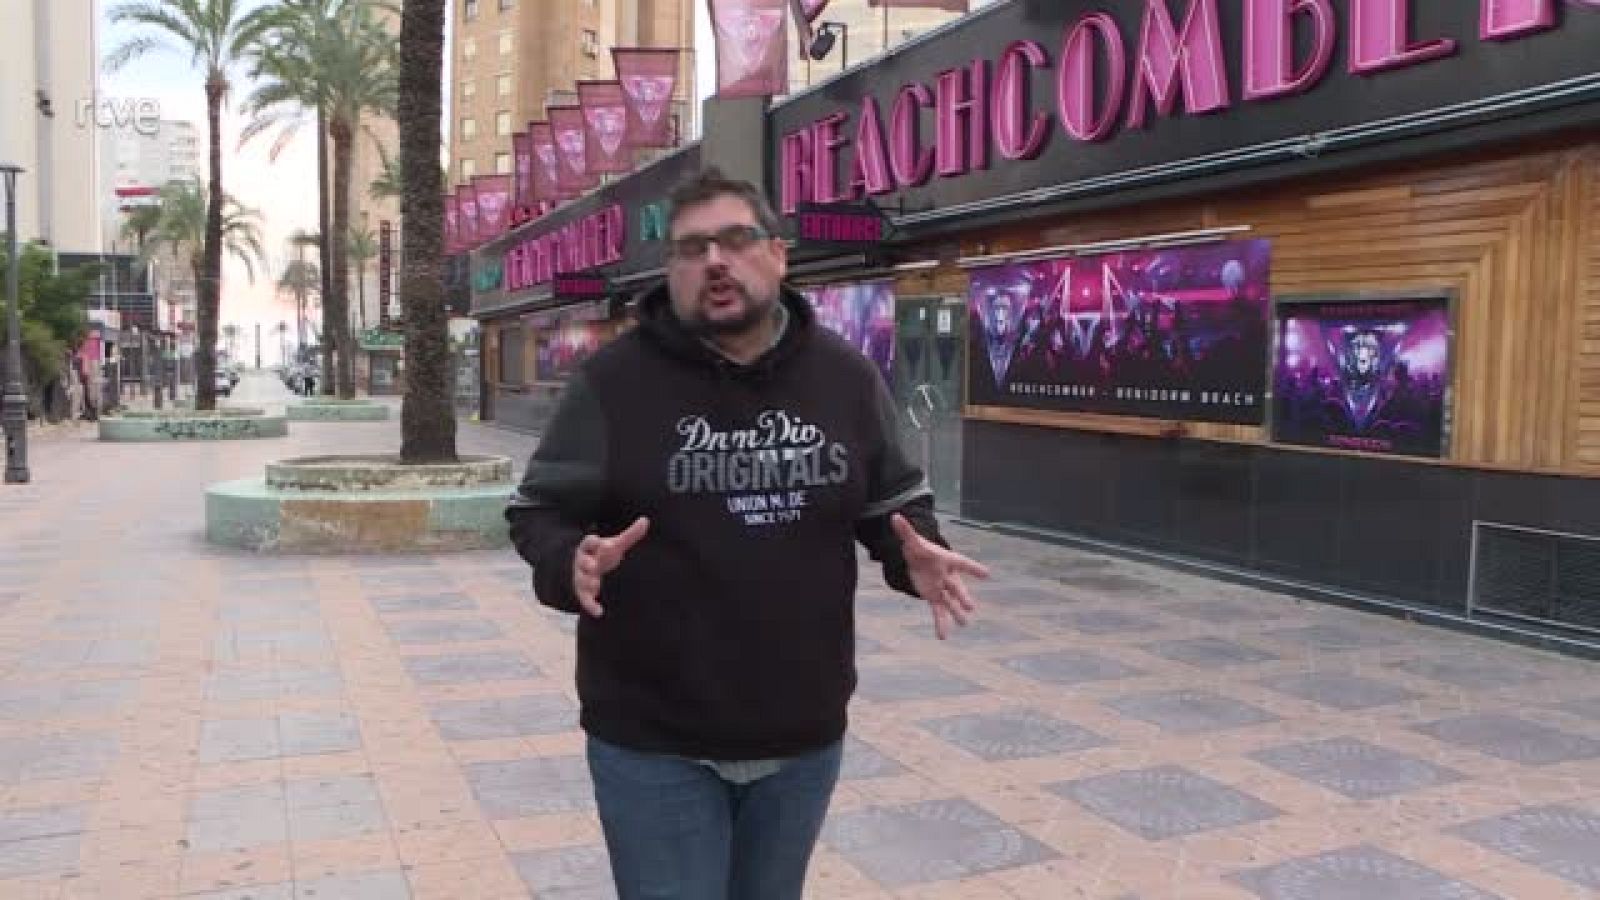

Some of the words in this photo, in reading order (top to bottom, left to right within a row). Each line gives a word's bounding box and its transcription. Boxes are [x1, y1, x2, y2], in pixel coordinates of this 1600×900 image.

[779, 0, 1600, 215] BEACHCOMB
[668, 442, 849, 493] ORIGINALS
[727, 494, 768, 513] UNION
